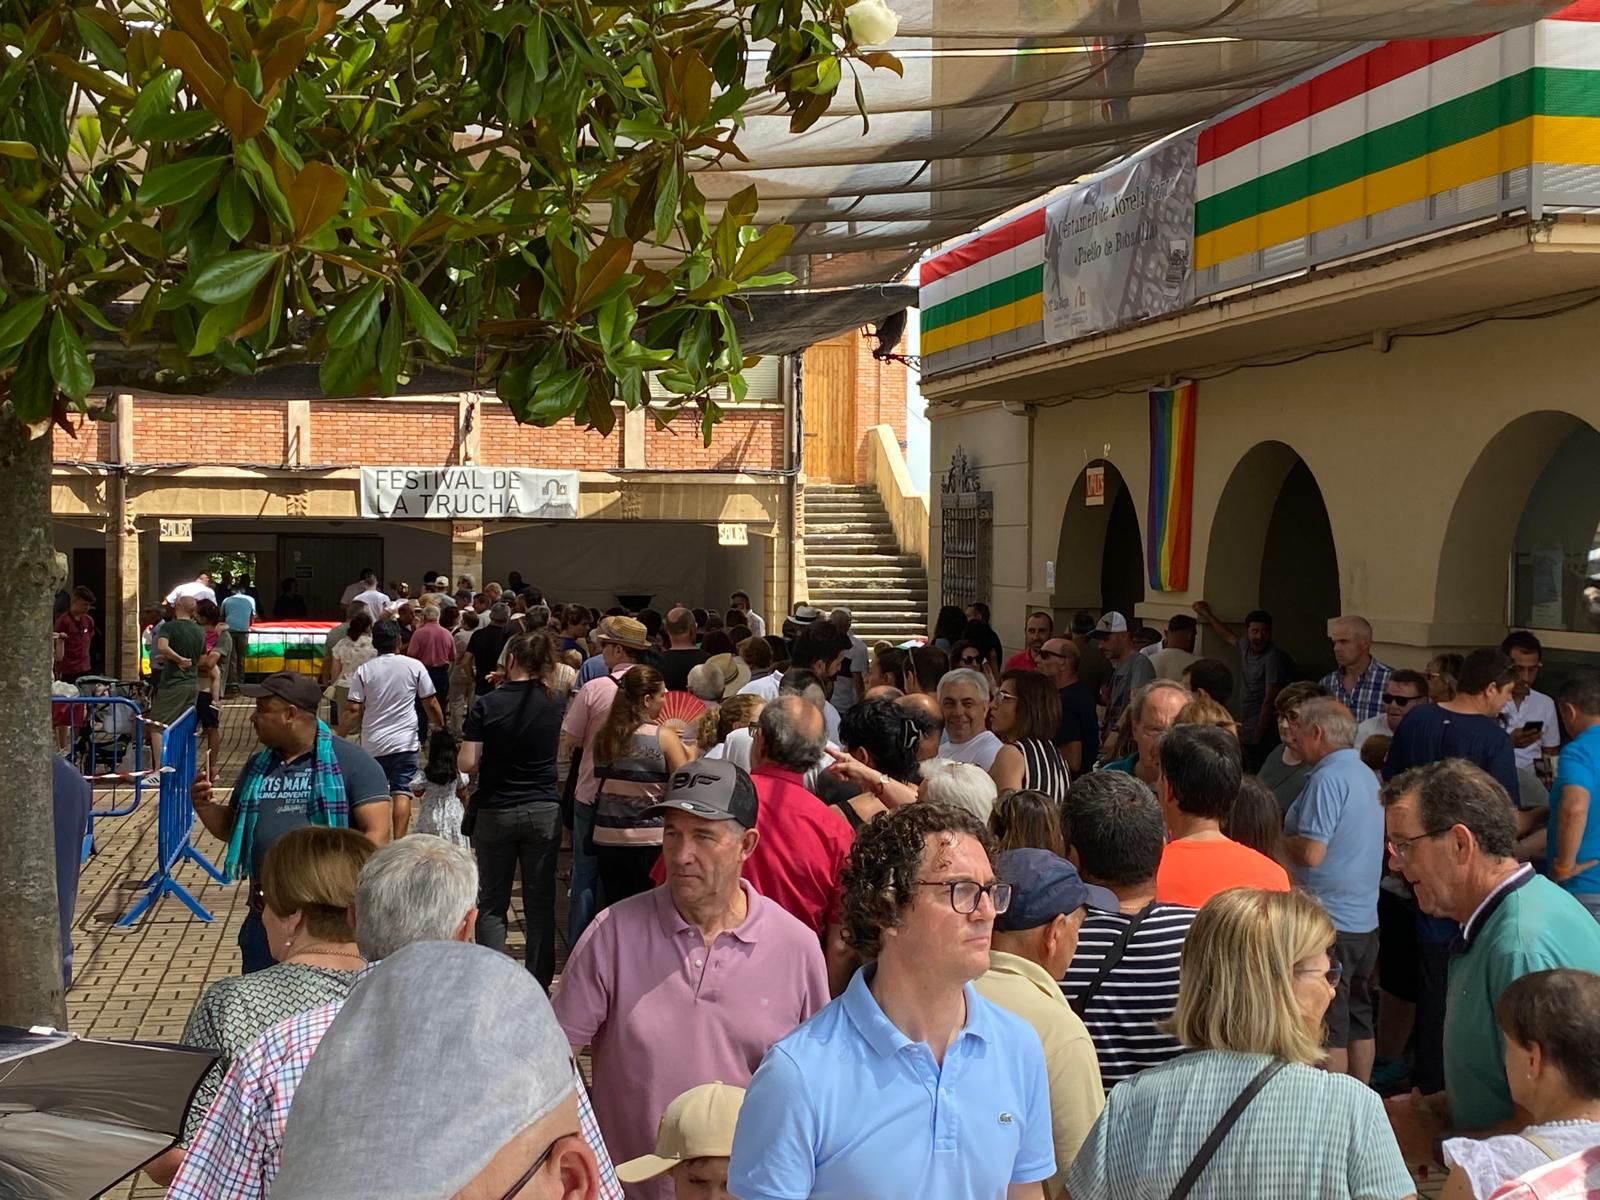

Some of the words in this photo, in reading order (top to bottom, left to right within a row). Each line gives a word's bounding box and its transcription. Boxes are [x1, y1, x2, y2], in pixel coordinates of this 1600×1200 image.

[1058, 210, 1098, 239] Certamen
[1099, 202, 1109, 222] de
[1111, 186, 1145, 218] Novela
[1104, 238, 1113, 255] de
[375, 470, 484, 490] FESTIVAL
[494, 470, 521, 490] DE
[376, 495, 409, 514] LA
[419, 494, 521, 514] TRUCHA
